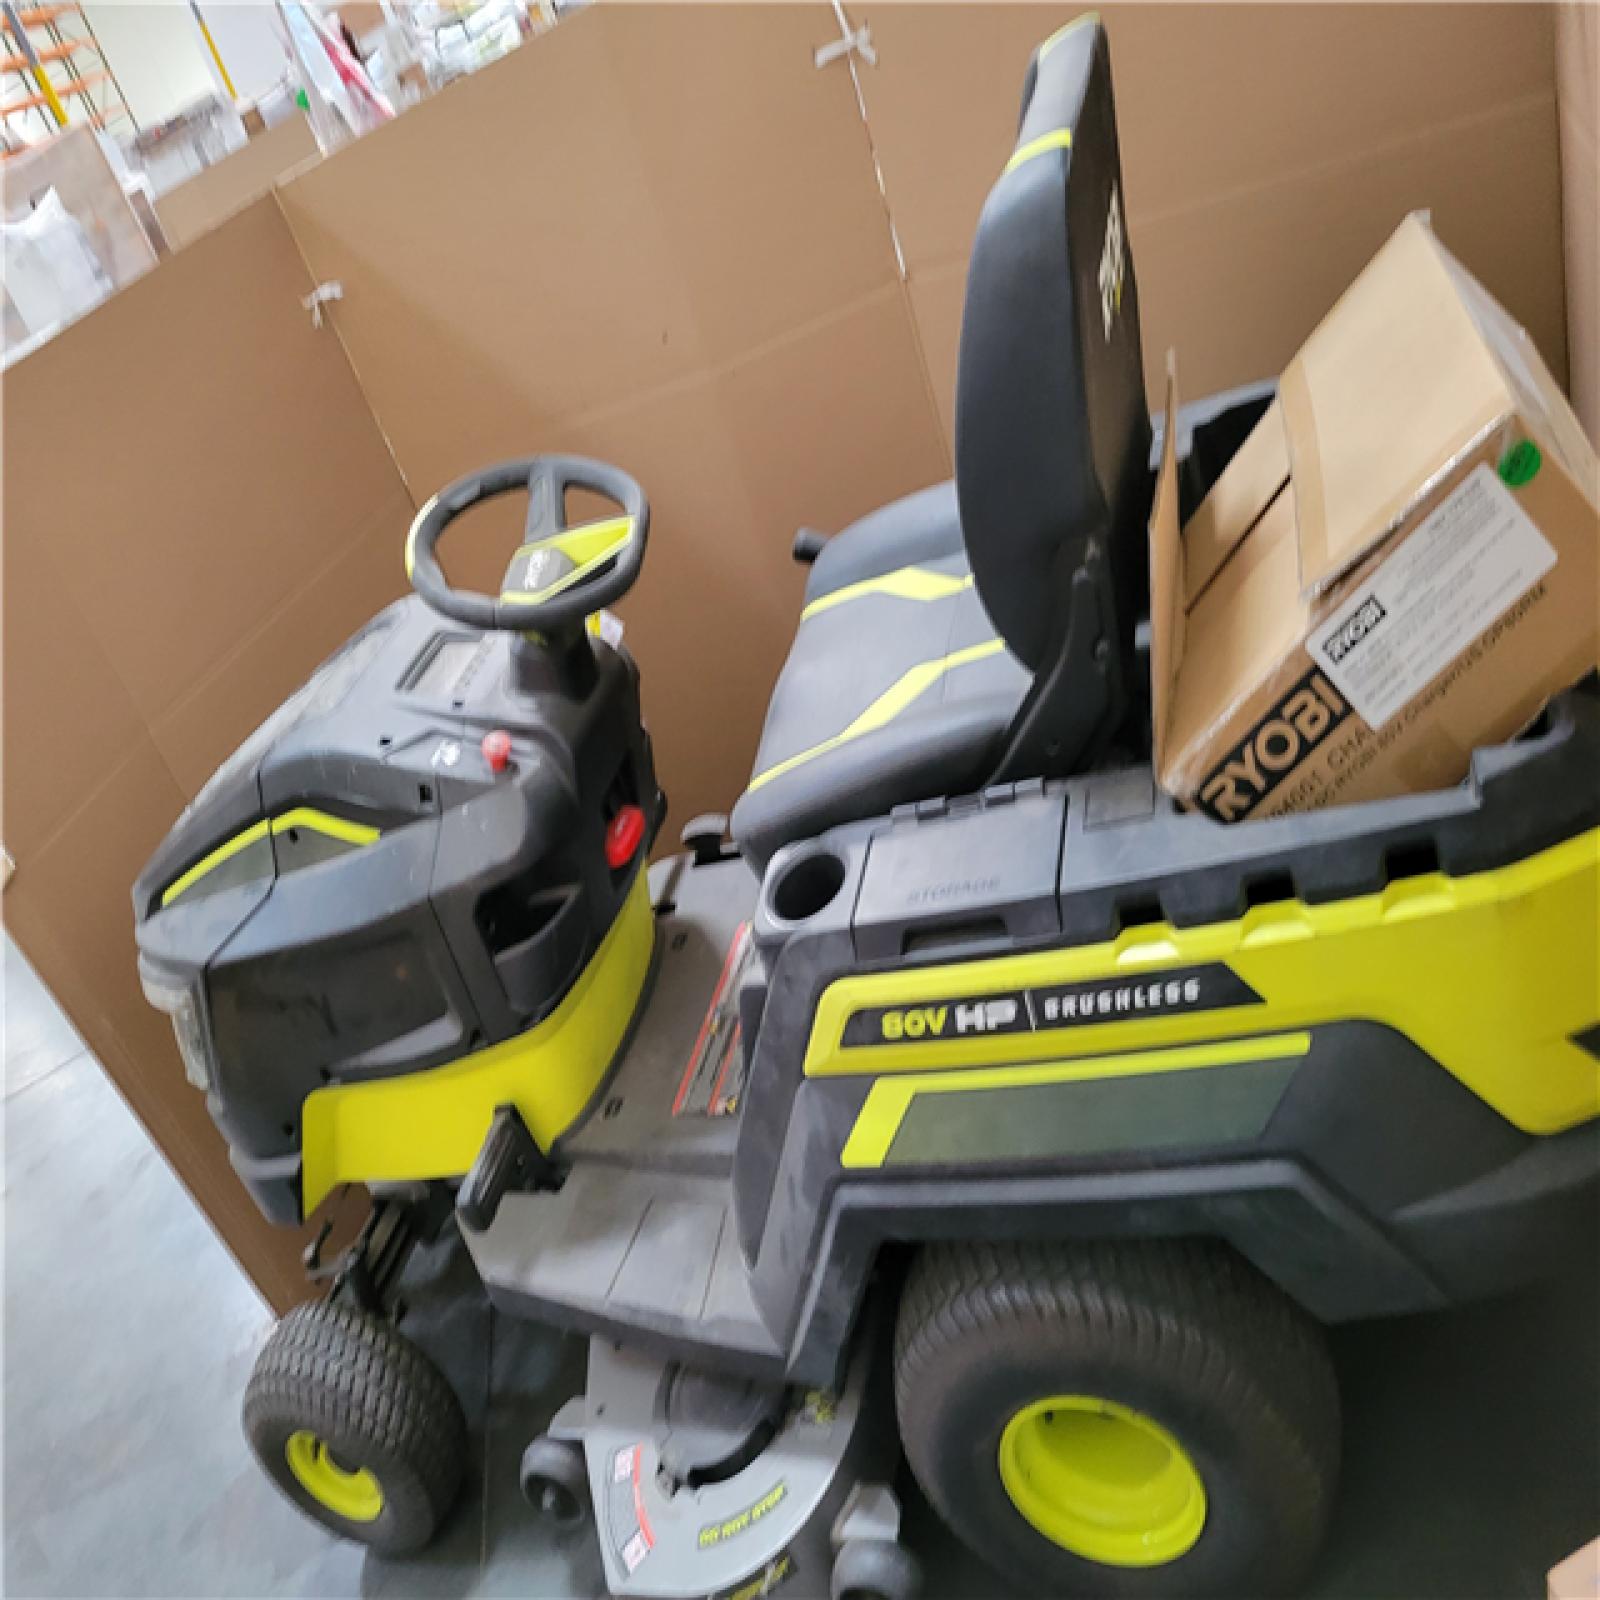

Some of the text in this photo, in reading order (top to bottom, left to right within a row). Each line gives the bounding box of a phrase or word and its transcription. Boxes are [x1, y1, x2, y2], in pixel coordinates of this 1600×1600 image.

[1323, 596, 1386, 663] RYOBI
[1202, 674, 1344, 815] RYOBI
[954, 999, 1017, 1033] HP
[1044, 977, 1200, 1021] BRUSHLESS
